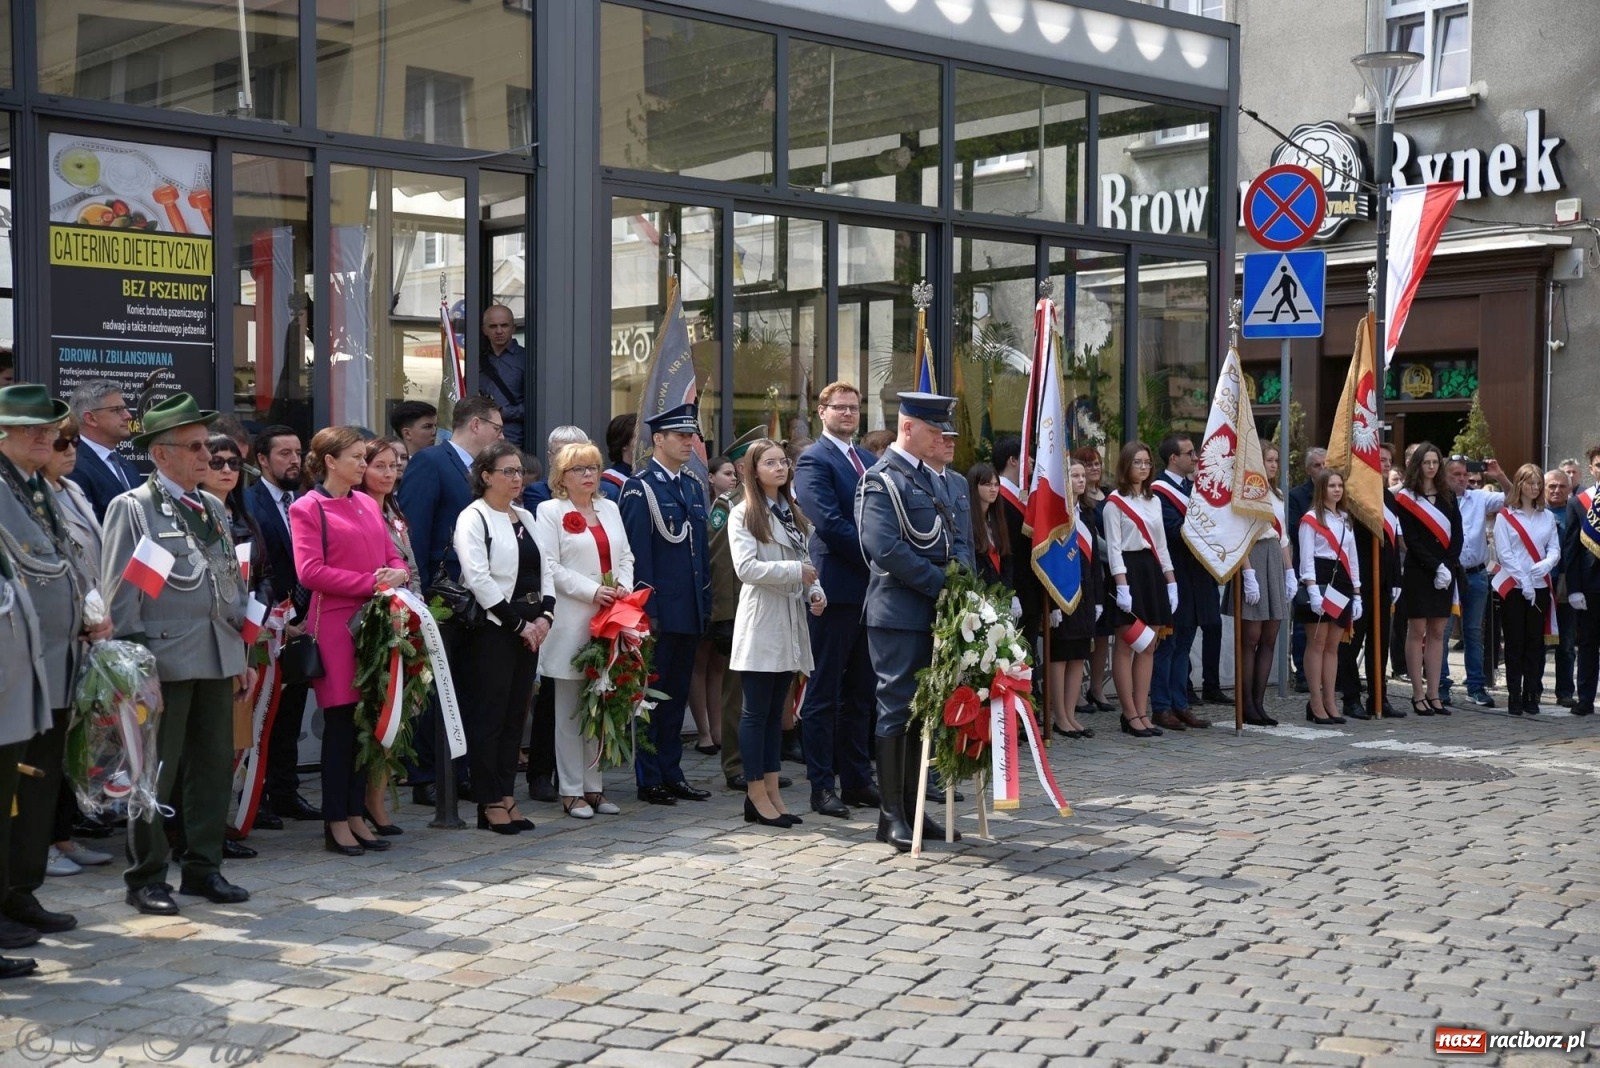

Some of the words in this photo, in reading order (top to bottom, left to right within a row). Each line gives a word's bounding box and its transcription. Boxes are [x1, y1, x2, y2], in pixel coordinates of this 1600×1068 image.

[54, 231, 120, 264] CATERING
[123, 237, 208, 271] DIETETYCZNY
[122, 278, 146, 297] BEZ
[150, 280, 207, 301] PSZENICY
[126, 303, 145, 315] Koniec
[146, 304, 167, 317] brzucha
[168, 307, 203, 321] pszenicznego
[102, 319, 127, 334] nadwagi
[127, 323, 131, 331] a
[131, 320, 147, 332] także
[147, 322, 182, 337] niezdrowego
[182, 324, 207, 338] jedzenia!
[59, 347, 98, 363] ZDROWA
[105, 349, 174, 366] ZBILANSOWANA
[59, 367, 99, 377] Profesjonalnie
[100, 369, 133, 378] opracowana
[668, 360, 682, 375] NR
[623, 489, 643, 498] POLICJA
[441, 673, 456, 721] Senator
